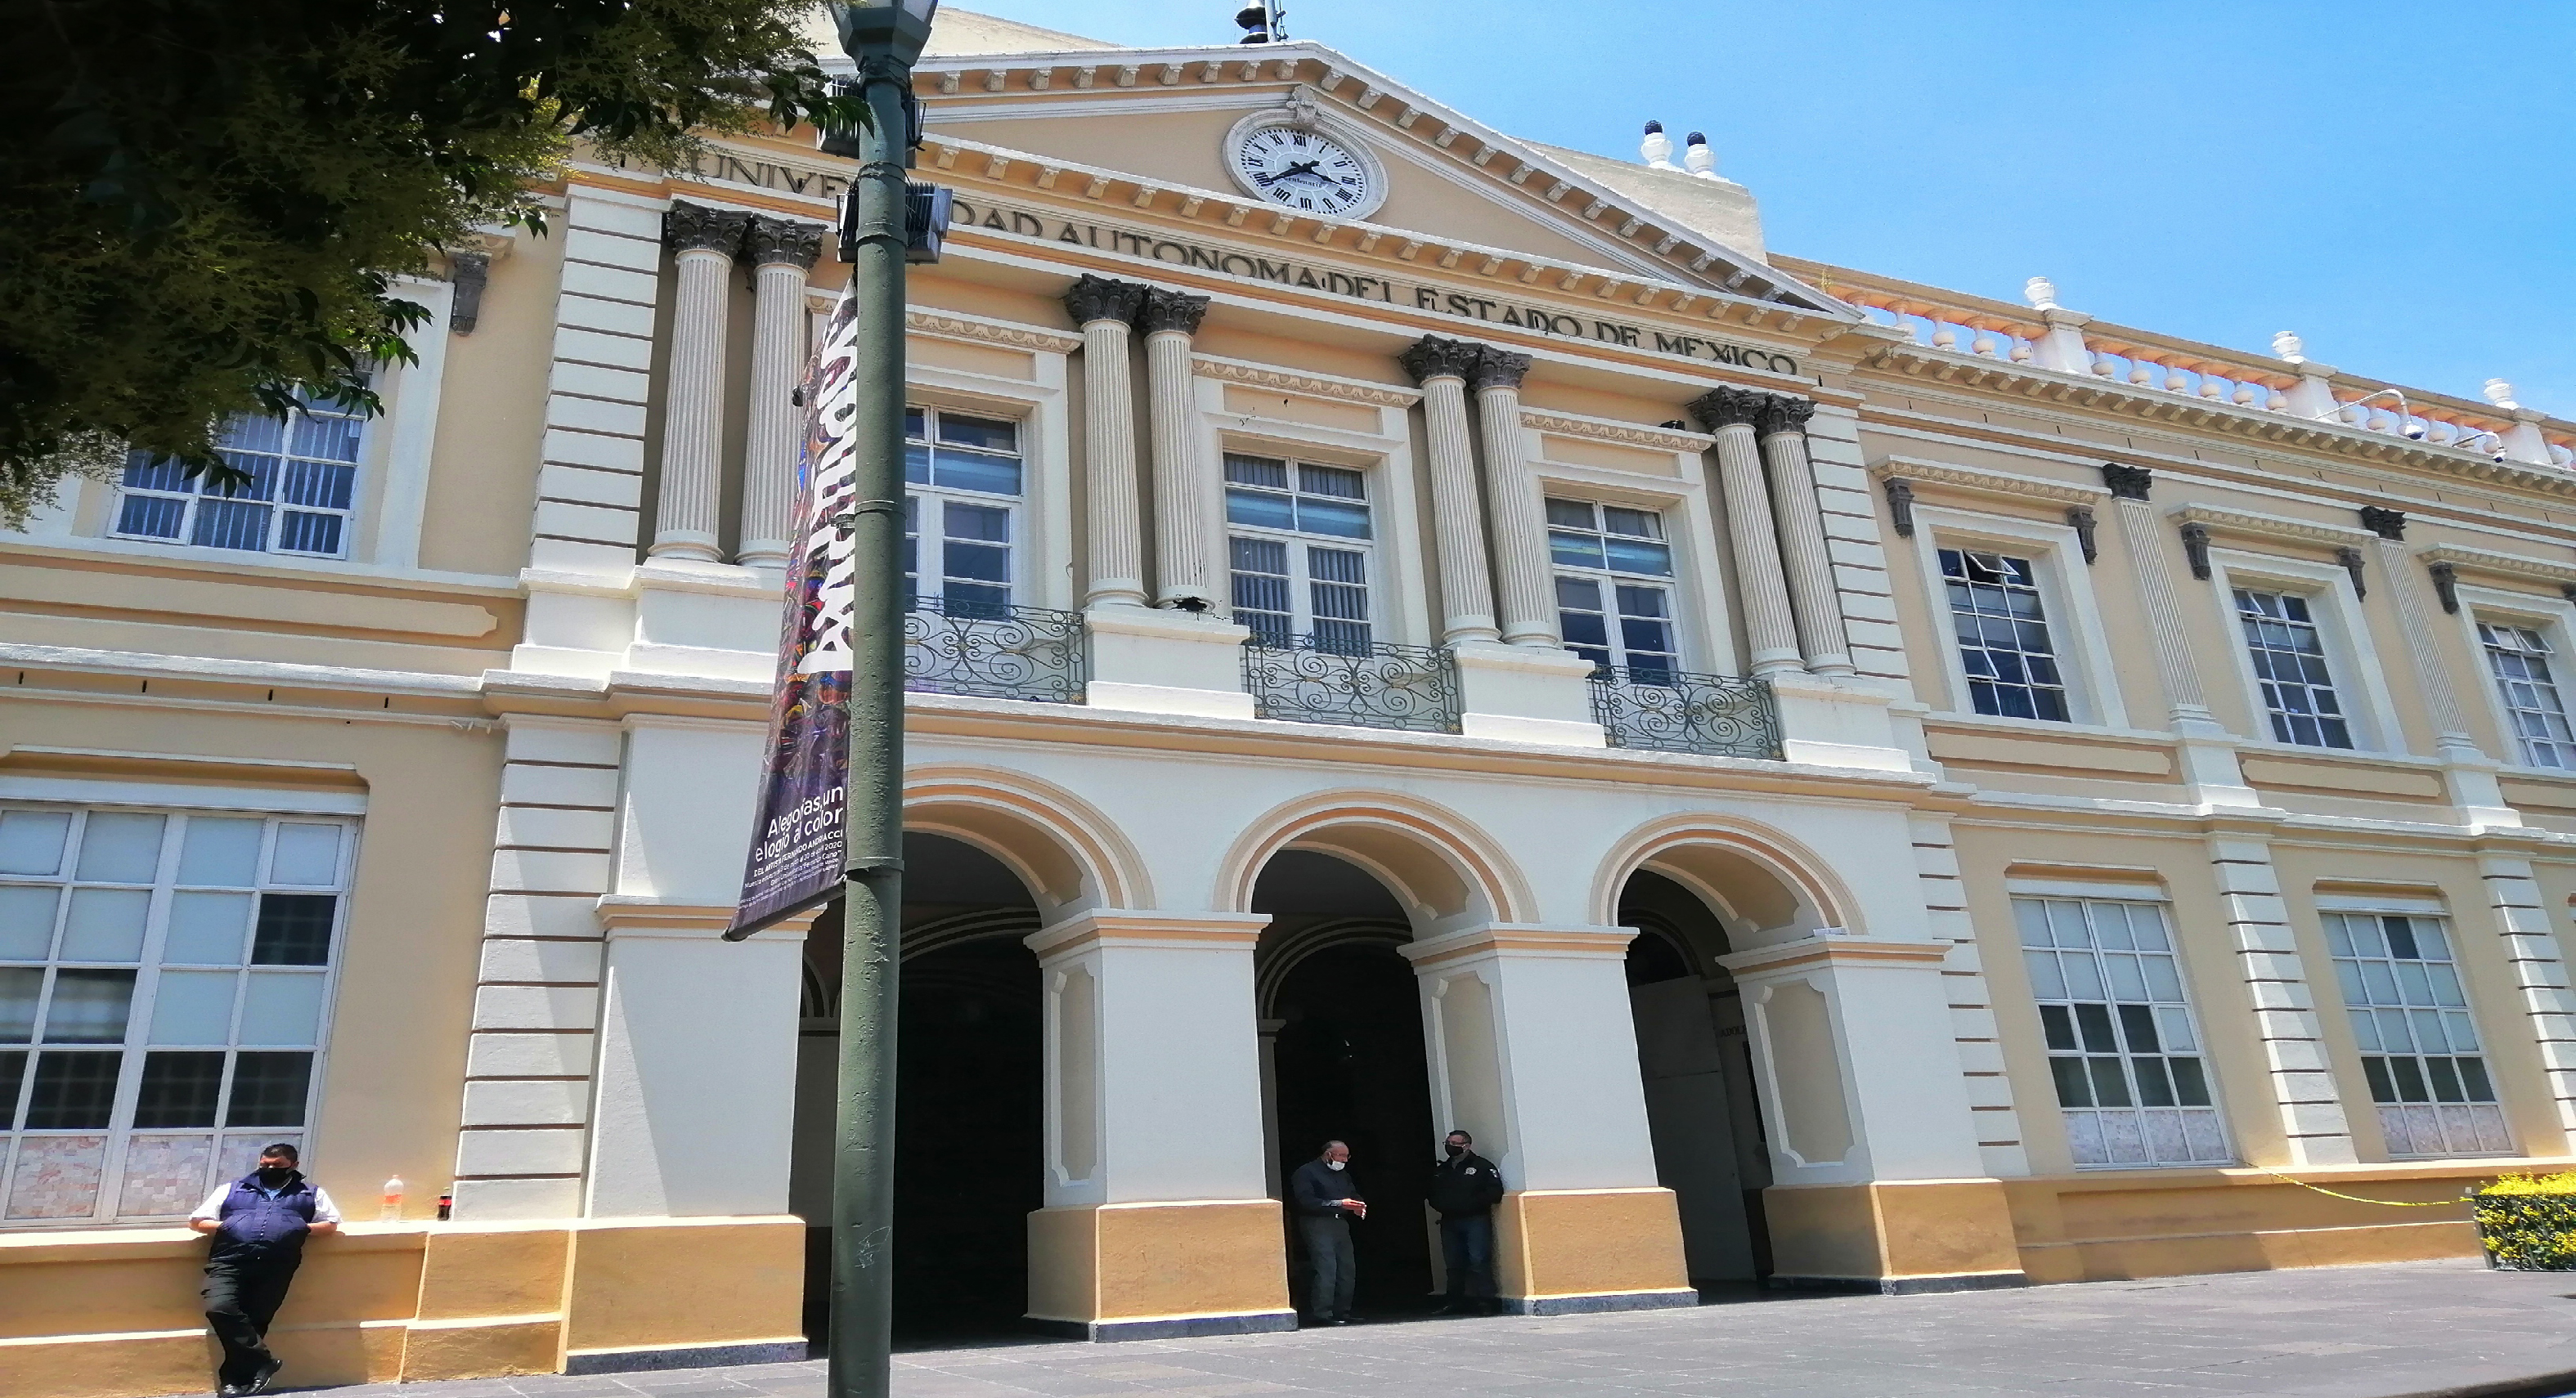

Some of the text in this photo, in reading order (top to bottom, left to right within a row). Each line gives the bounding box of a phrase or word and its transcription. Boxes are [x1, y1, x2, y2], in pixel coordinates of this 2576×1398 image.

[1268, 133, 1285, 146] XI
[1293, 134, 1307, 147] XII
[1252, 142, 1268, 155] X
[1247, 156, 1264, 168] IX
[1341, 176, 1357, 186] III
[1059, 222, 1323, 290] AUTONOMA
[1328, 271, 1411, 306] DEL
[1416, 286, 1583, 337] ESTADO
[1595, 320, 1645, 349] DE
[1654, 331, 1797, 376] MEXICO
[823, 786, 843, 807] un
[756, 831, 790, 863] elogio
[804, 807, 844, 836] color
[824, 840, 843, 851] 2020
